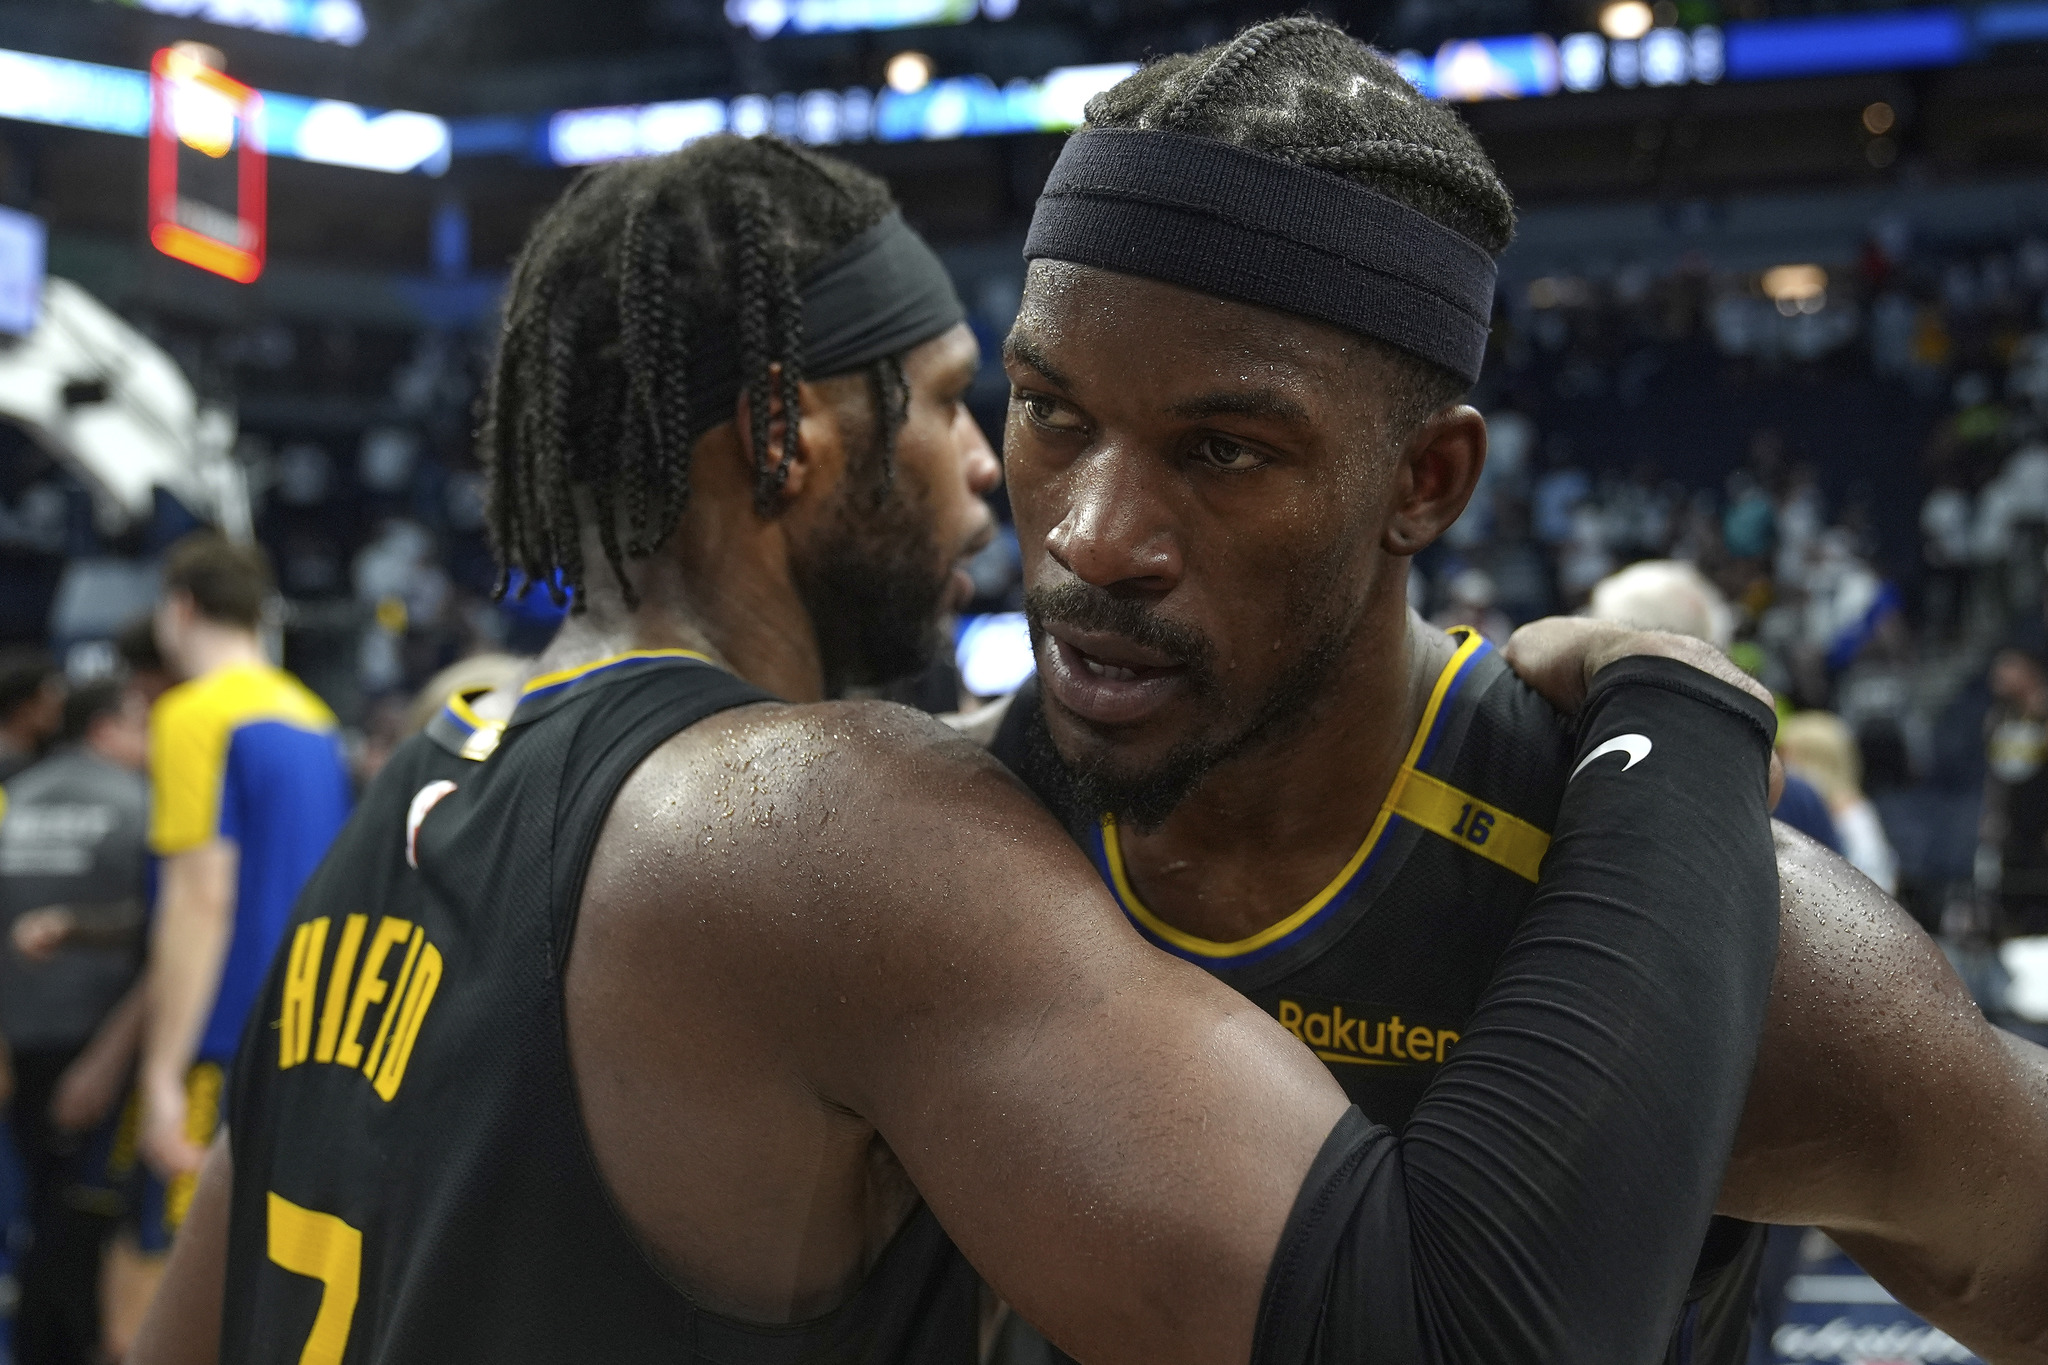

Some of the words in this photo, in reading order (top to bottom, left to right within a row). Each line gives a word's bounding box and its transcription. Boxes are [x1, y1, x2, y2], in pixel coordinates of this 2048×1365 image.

[1451, 803, 1496, 846] 16
[1278, 1000, 1462, 1064] Rakuten
[266, 1189, 364, 1365] 7
